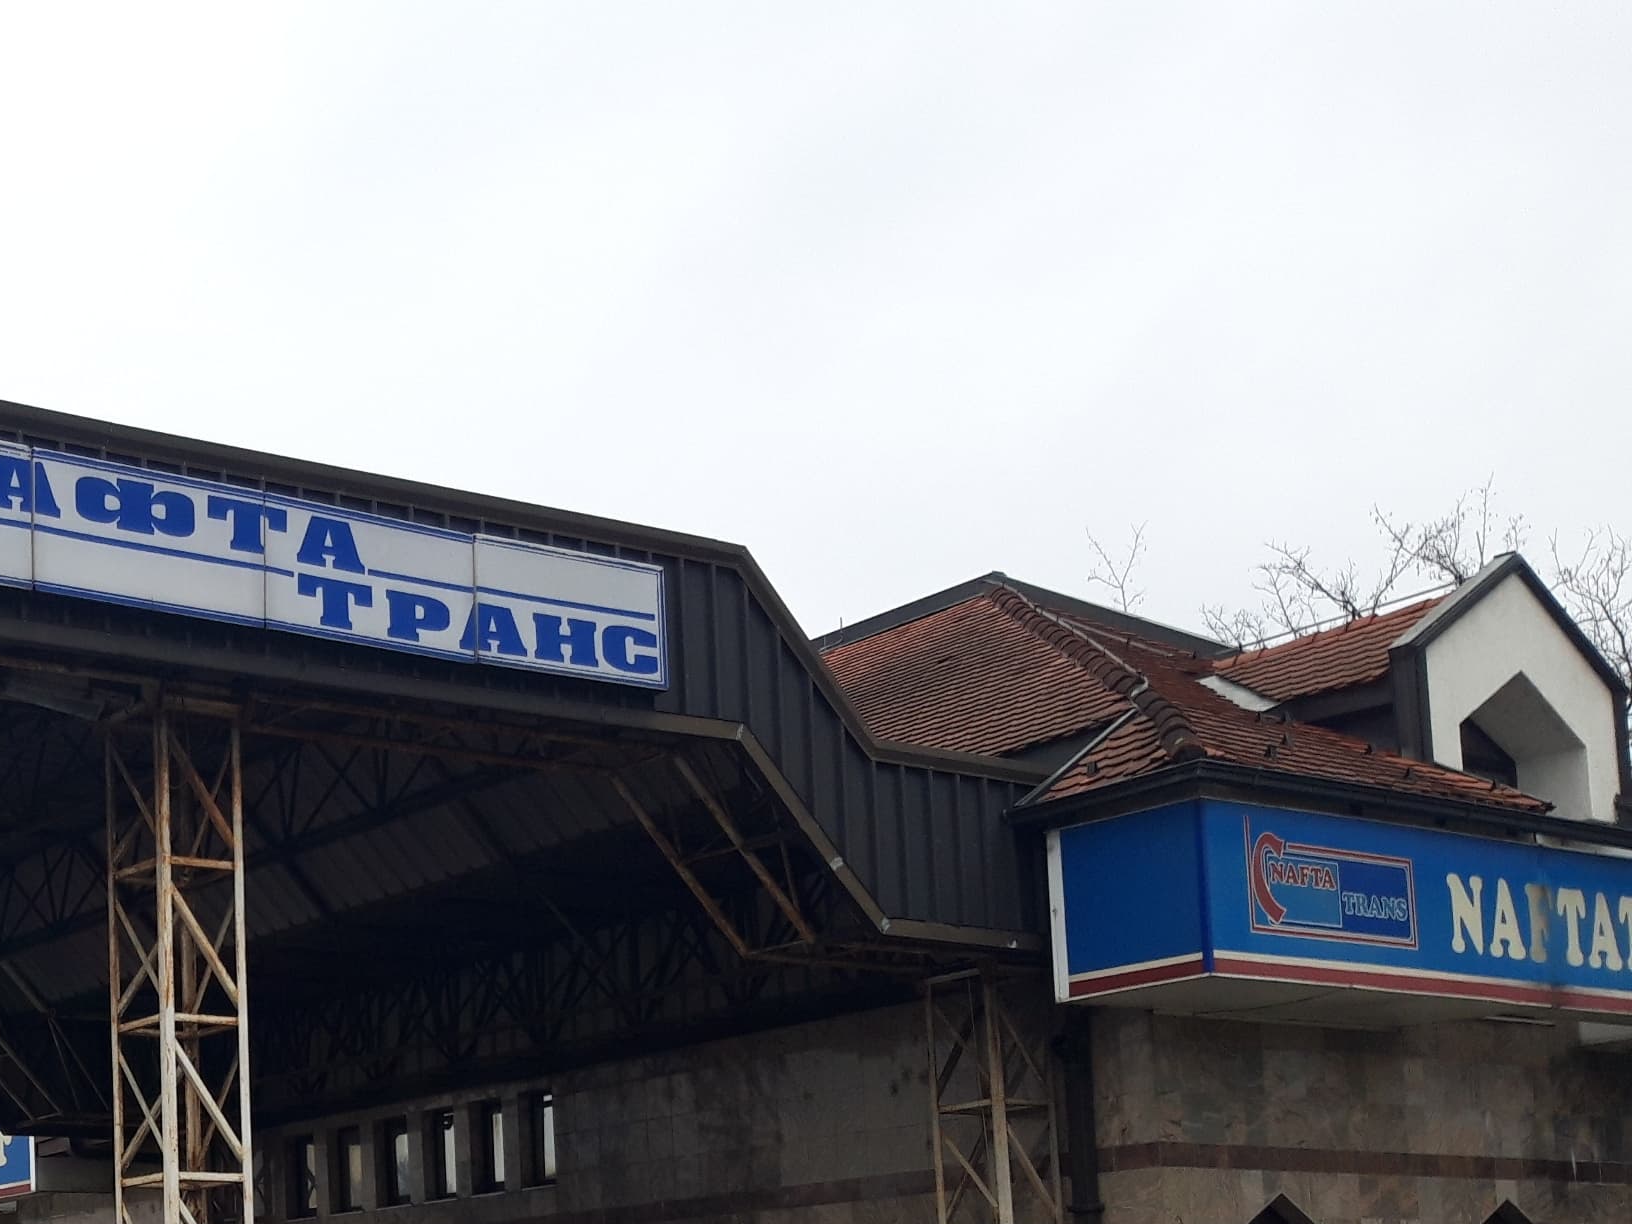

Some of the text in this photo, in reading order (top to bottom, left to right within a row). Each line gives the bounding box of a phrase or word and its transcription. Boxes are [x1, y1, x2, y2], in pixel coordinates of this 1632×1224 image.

[297, 572, 660, 675] ТРАНС
[1269, 860, 1337, 891] NAFTA
[1342, 892, 1408, 922] TRANS
